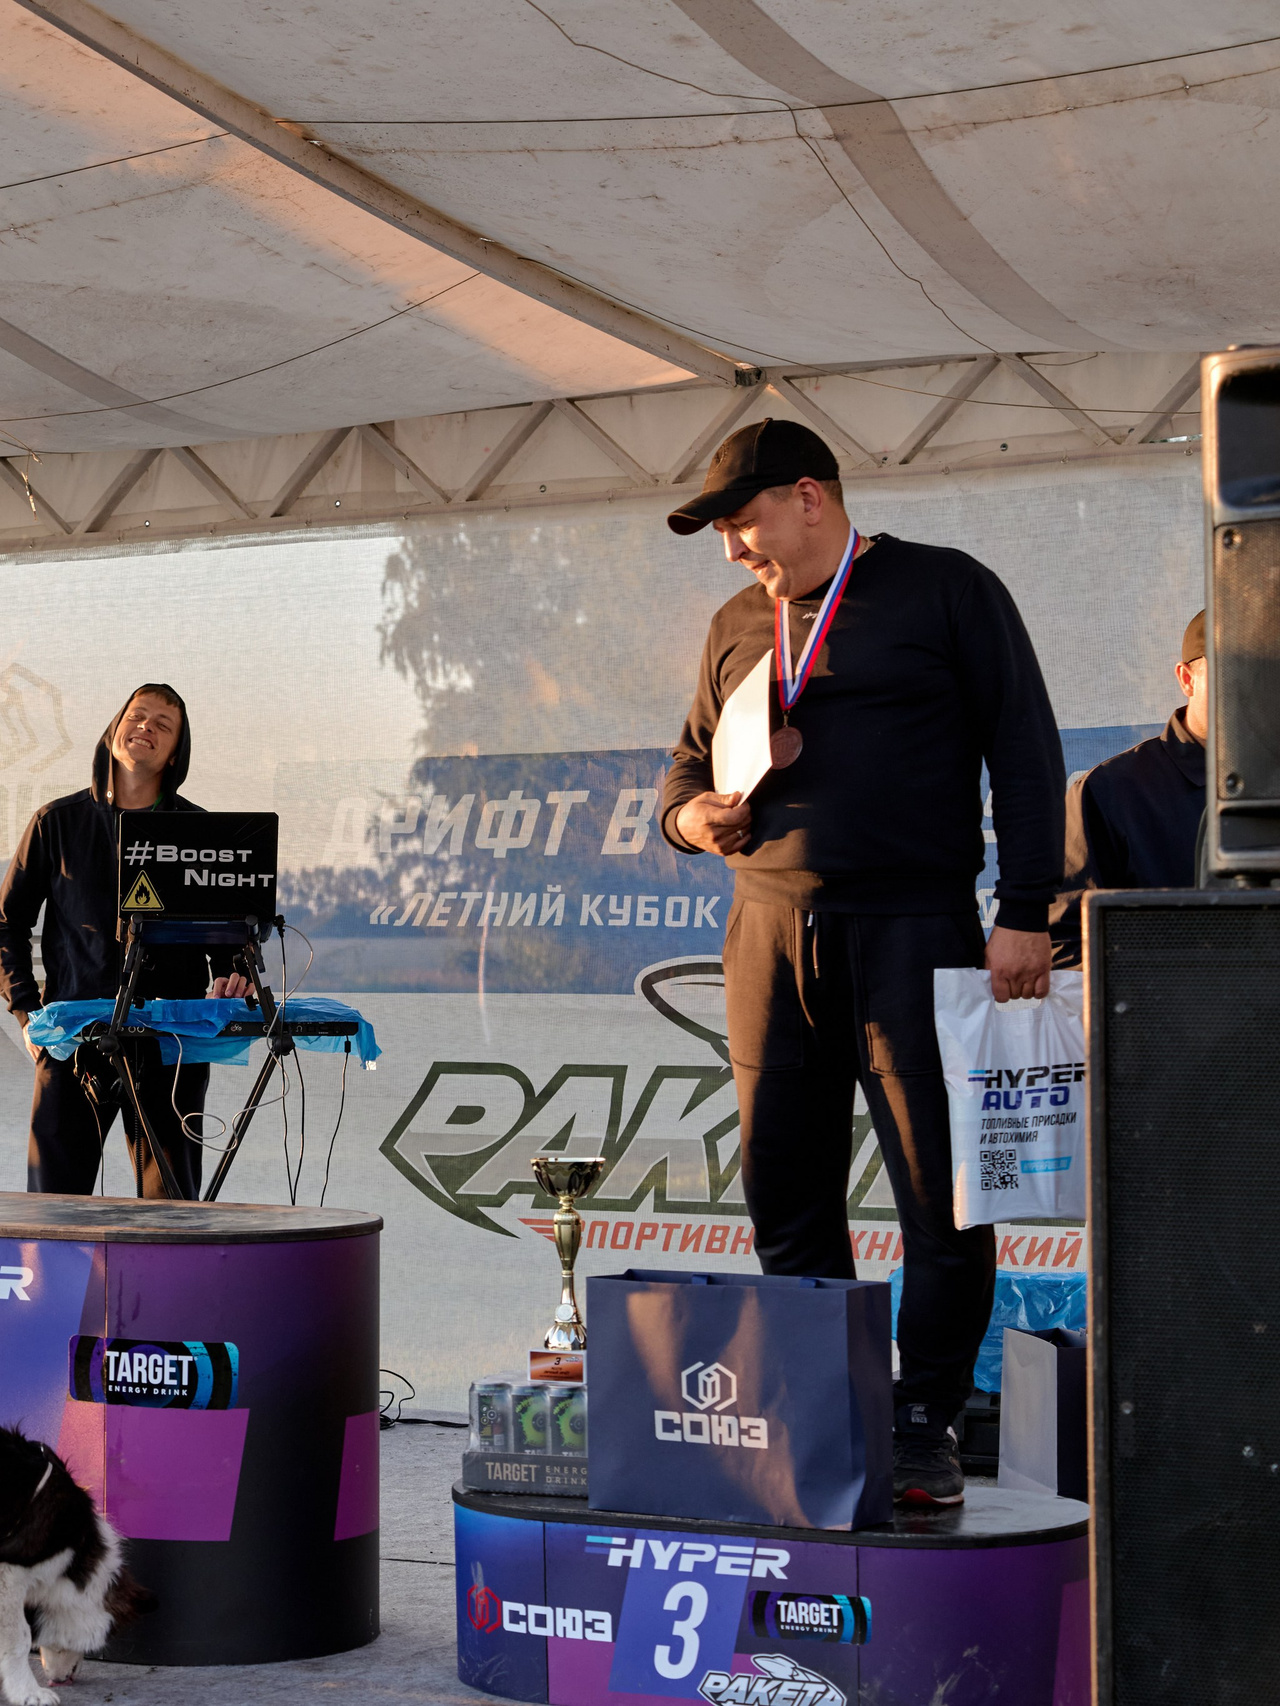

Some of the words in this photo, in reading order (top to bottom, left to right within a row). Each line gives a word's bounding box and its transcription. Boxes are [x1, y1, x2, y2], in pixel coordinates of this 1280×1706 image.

[322, 789, 590, 865] ДРИФТ
[601, 788, 658, 855] В
[369, 884, 568, 927] «ЛЕТНИЙ
[579, 894, 720, 928] КУБОК
[981, 1086, 1070, 1111] AUTO
[981, 1116, 1029, 1130] ТОПЛИВНЫЕ
[1031, 1112, 1077, 1128] ПРИСАДКИ
[980, 1133, 987, 1144] И
[988, 1131, 1038, 1144] АВТОХИМИЯ
[106, 1350, 194, 1386] TARGET
[554, 1356, 562, 1366] 3
[108, 1385, 147, 1394] ENERGY
[153, 1387, 188, 1396] DRINK
[654, 1410, 769, 1449] СОЮЗ
[485, 1461, 538, 1483] TARGET
[545, 1465, 588, 1475] ENERG
[545, 1475, 587, 1486] DRINK
[607, 1538, 791, 1580] HYPER
[502, 1600, 612, 1642] СОЮЗ
[777, 1600, 841, 1626] TARGET
[653, 1580, 709, 1679] 3
[780, 1624, 811, 1632] ENERGY
